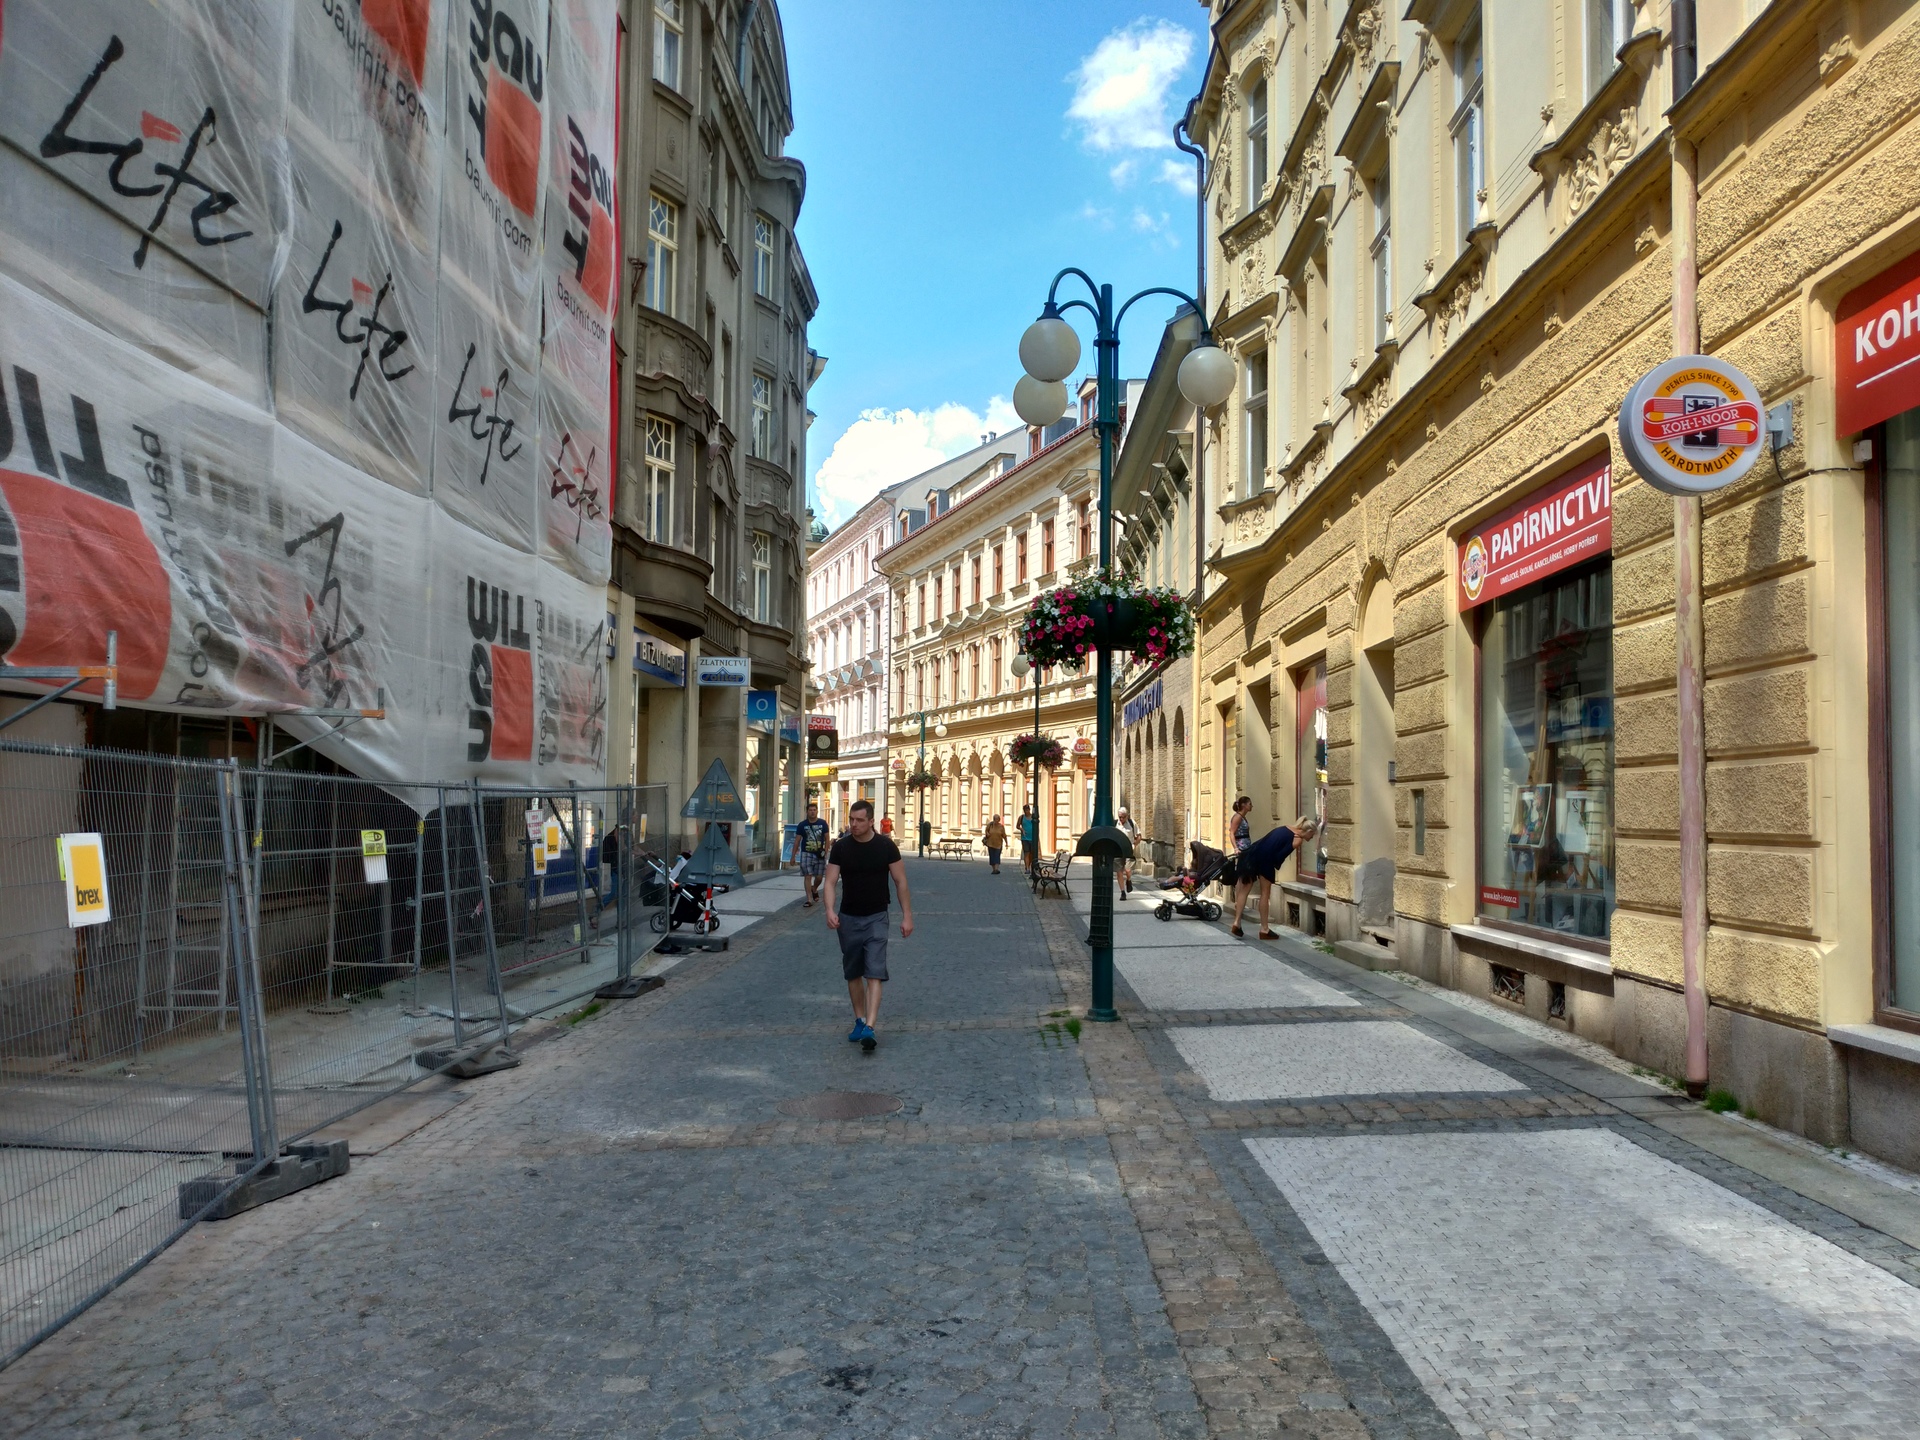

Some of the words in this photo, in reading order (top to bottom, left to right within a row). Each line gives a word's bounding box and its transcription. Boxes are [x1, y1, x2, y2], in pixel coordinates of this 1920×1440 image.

[465, 148, 532, 254] baumit.com
[557, 275, 608, 346] baumit.com
[1665, 373, 1696, 393] PENCILS
[1697, 371, 1721, 384] SINCE
[1721, 381, 1739, 397] 1790
[1661, 408, 1740, 435] KOH-I-NOOR
[1660, 446, 1738, 473] HARDTMUTH
[1491, 463, 1611, 564] PAPÍRNICTVÍ
[700, 658, 747, 667] ZLATNICTVÍ
[811, 716, 832, 725] FOTO
